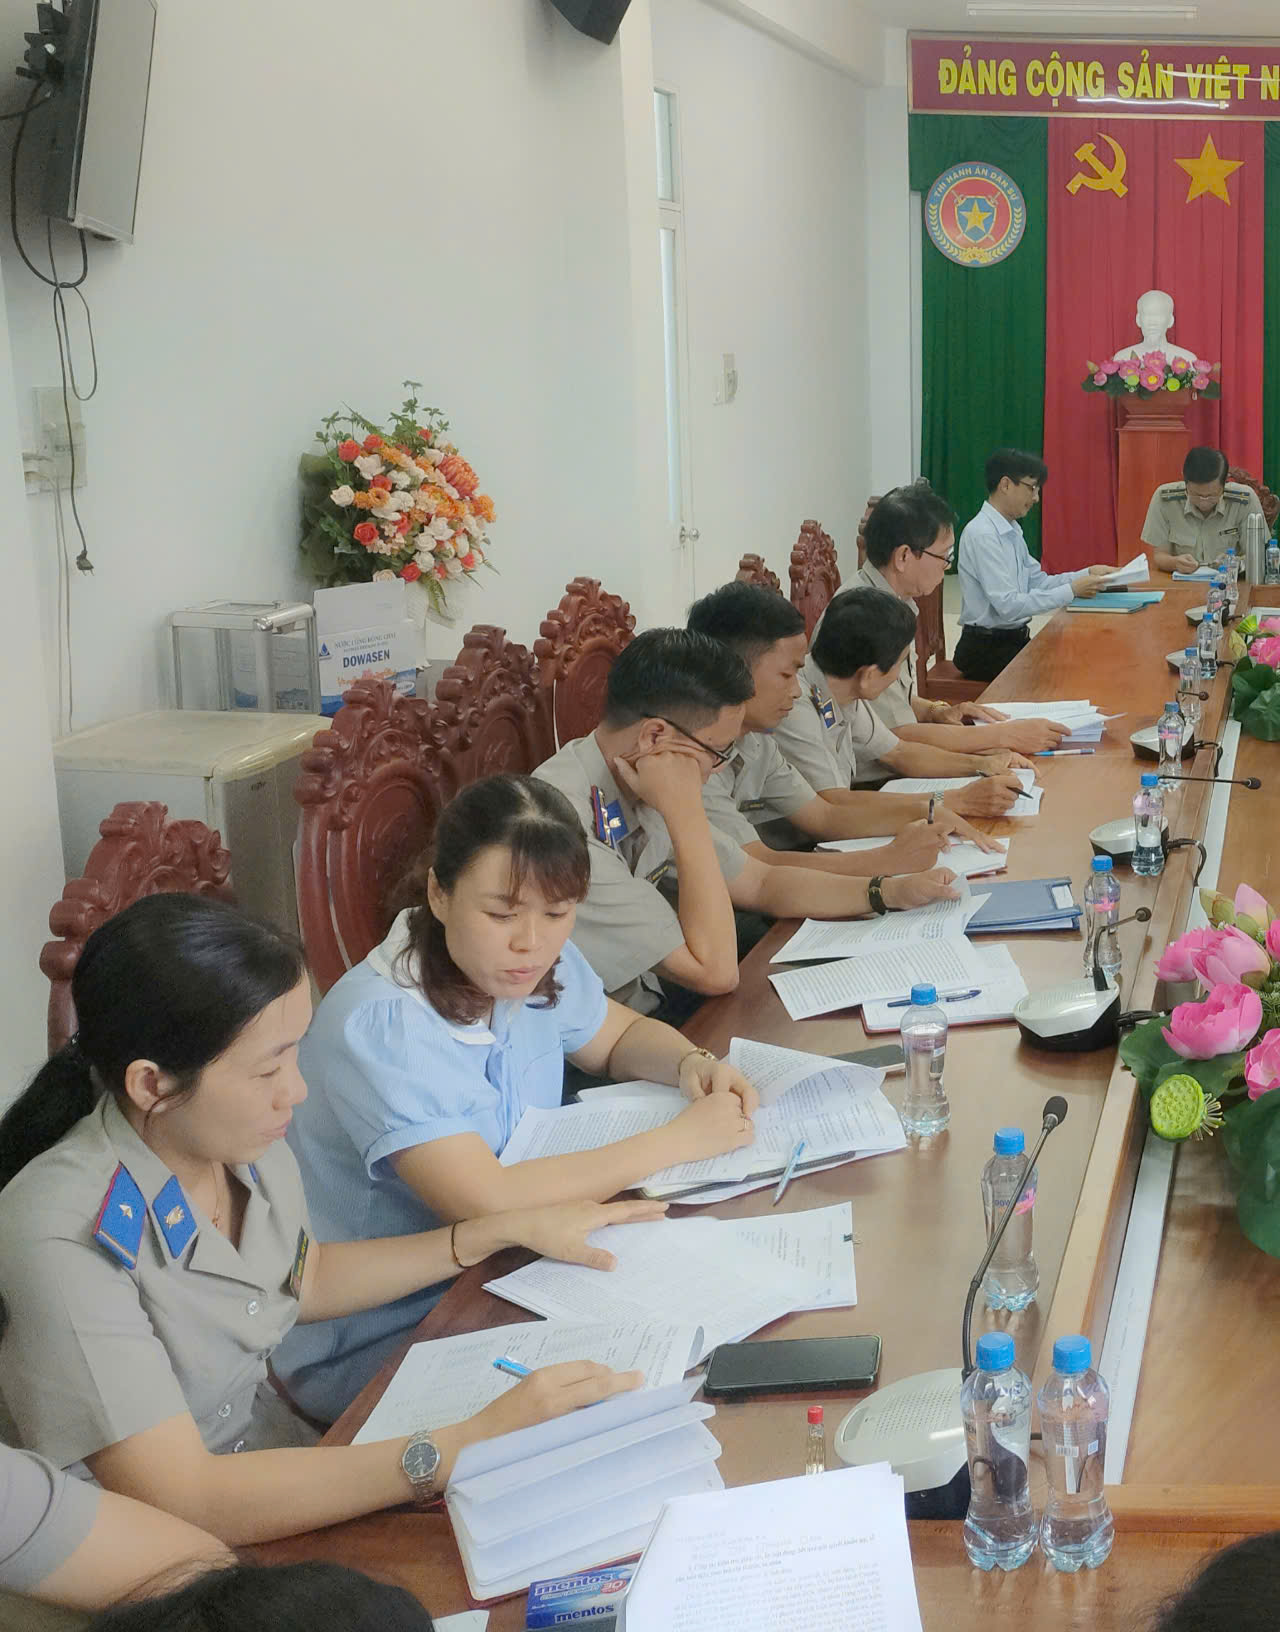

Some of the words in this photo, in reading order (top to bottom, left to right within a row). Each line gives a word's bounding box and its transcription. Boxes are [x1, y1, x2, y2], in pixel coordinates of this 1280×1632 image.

[938, 45, 1016, 95] ĐẢNG
[1026, 51, 1104, 107] CỘNG
[1118, 49, 1173, 99] SẢN
[343, 649, 390, 668] DOWASEN
[535, 1572, 614, 1597] mentos
[555, 1603, 615, 1624] mentos
